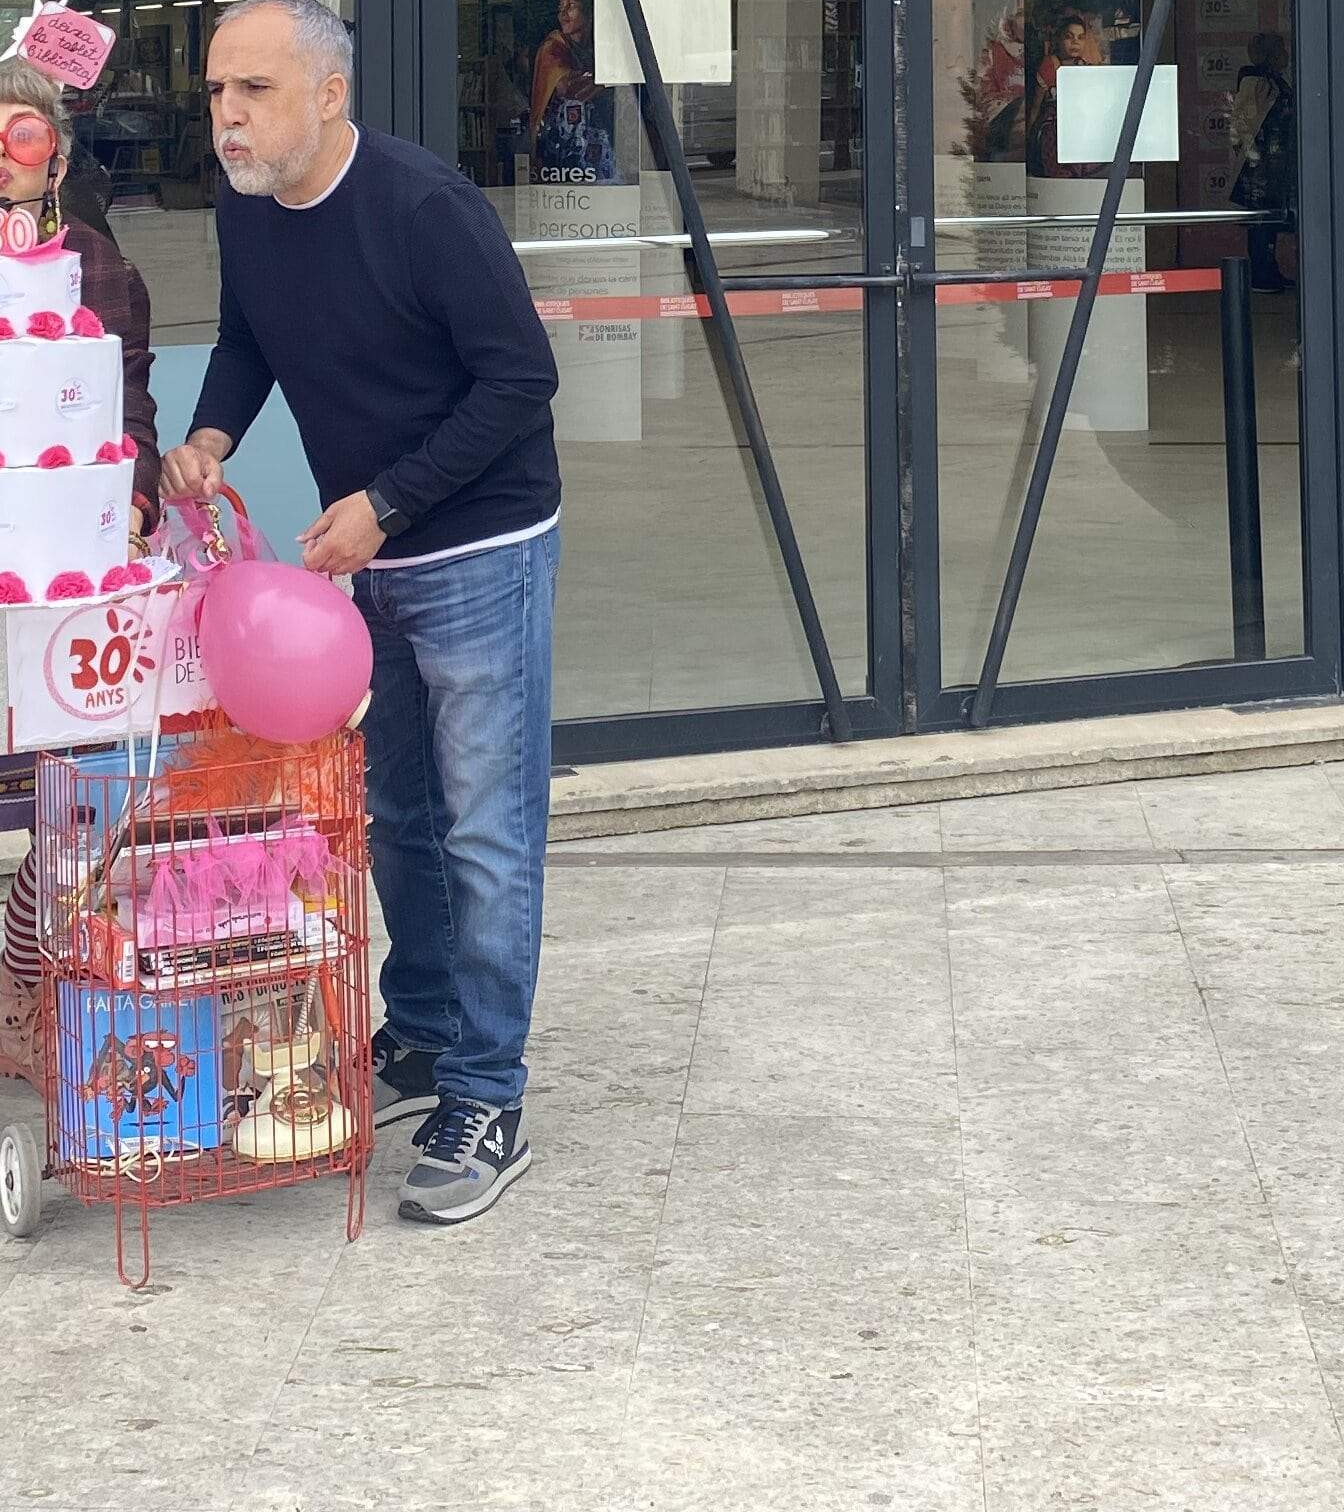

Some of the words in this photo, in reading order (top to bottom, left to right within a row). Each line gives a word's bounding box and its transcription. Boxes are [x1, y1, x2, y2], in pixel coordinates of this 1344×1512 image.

[540, 167, 597, 183] cares
[539, 222, 637, 240] persones
[60, 388, 76, 403] 30
[69, 635, 131, 690] 30
[85, 687, 125, 709] ANYS
